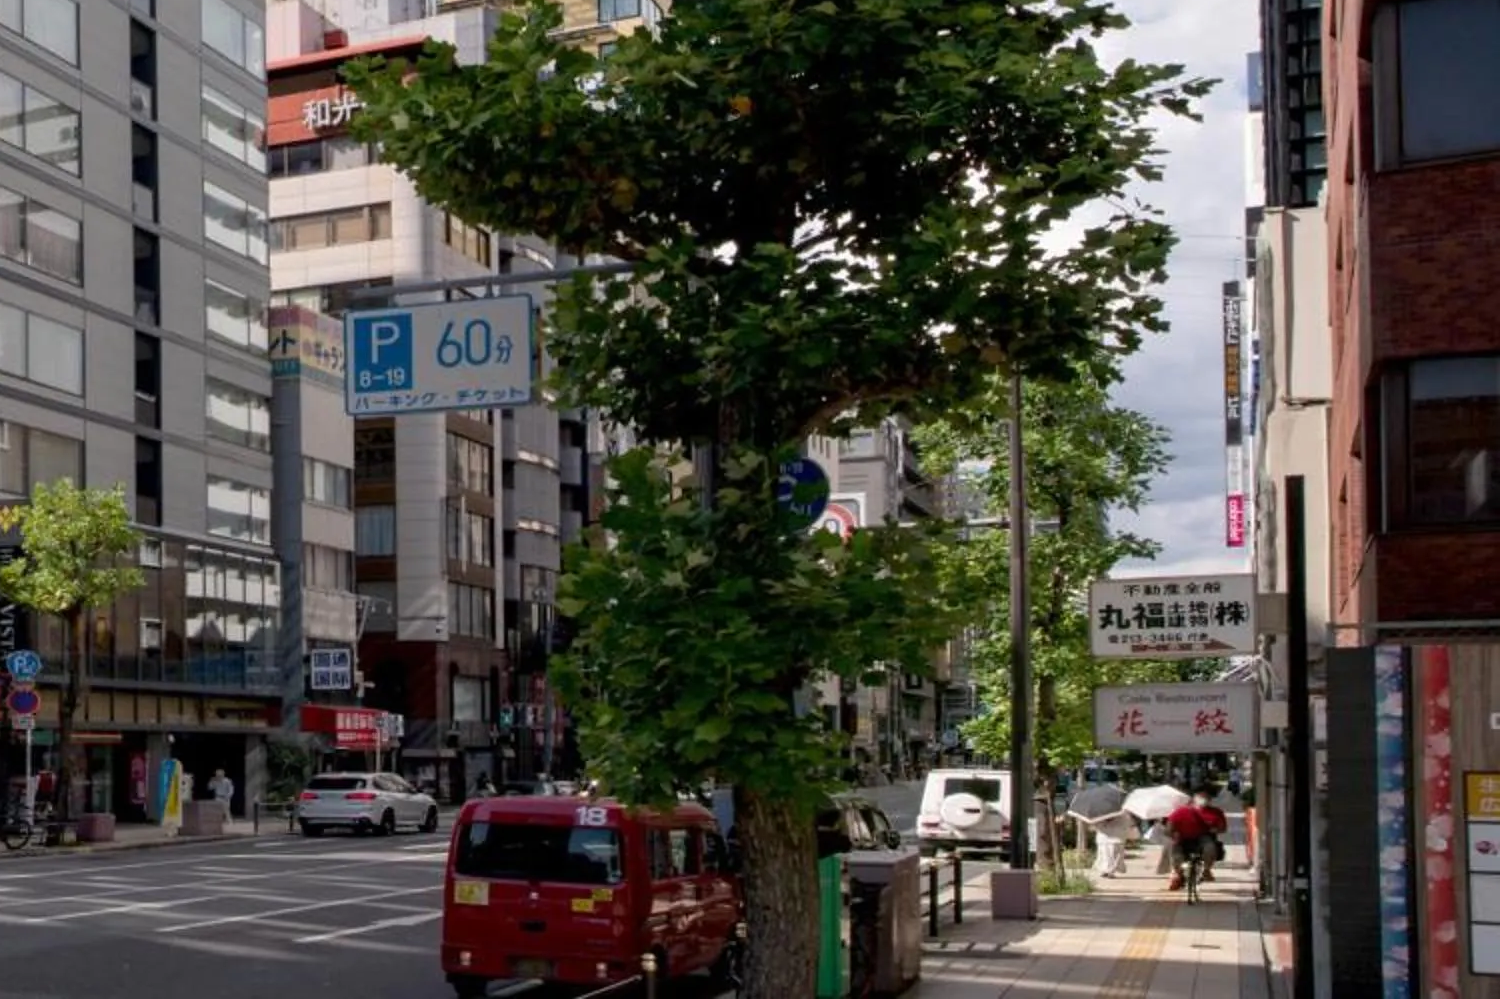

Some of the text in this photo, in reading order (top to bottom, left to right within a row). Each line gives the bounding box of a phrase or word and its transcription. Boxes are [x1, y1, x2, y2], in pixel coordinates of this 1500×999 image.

[371, 322, 400, 364] P
[437, 319, 513, 368] 60分
[359, 368, 405, 388] 8-19
[1123, 579, 1221, 597] 不動産全般
[1115, 709, 1148, 737] 花
[576, 806, 607, 826] 18
